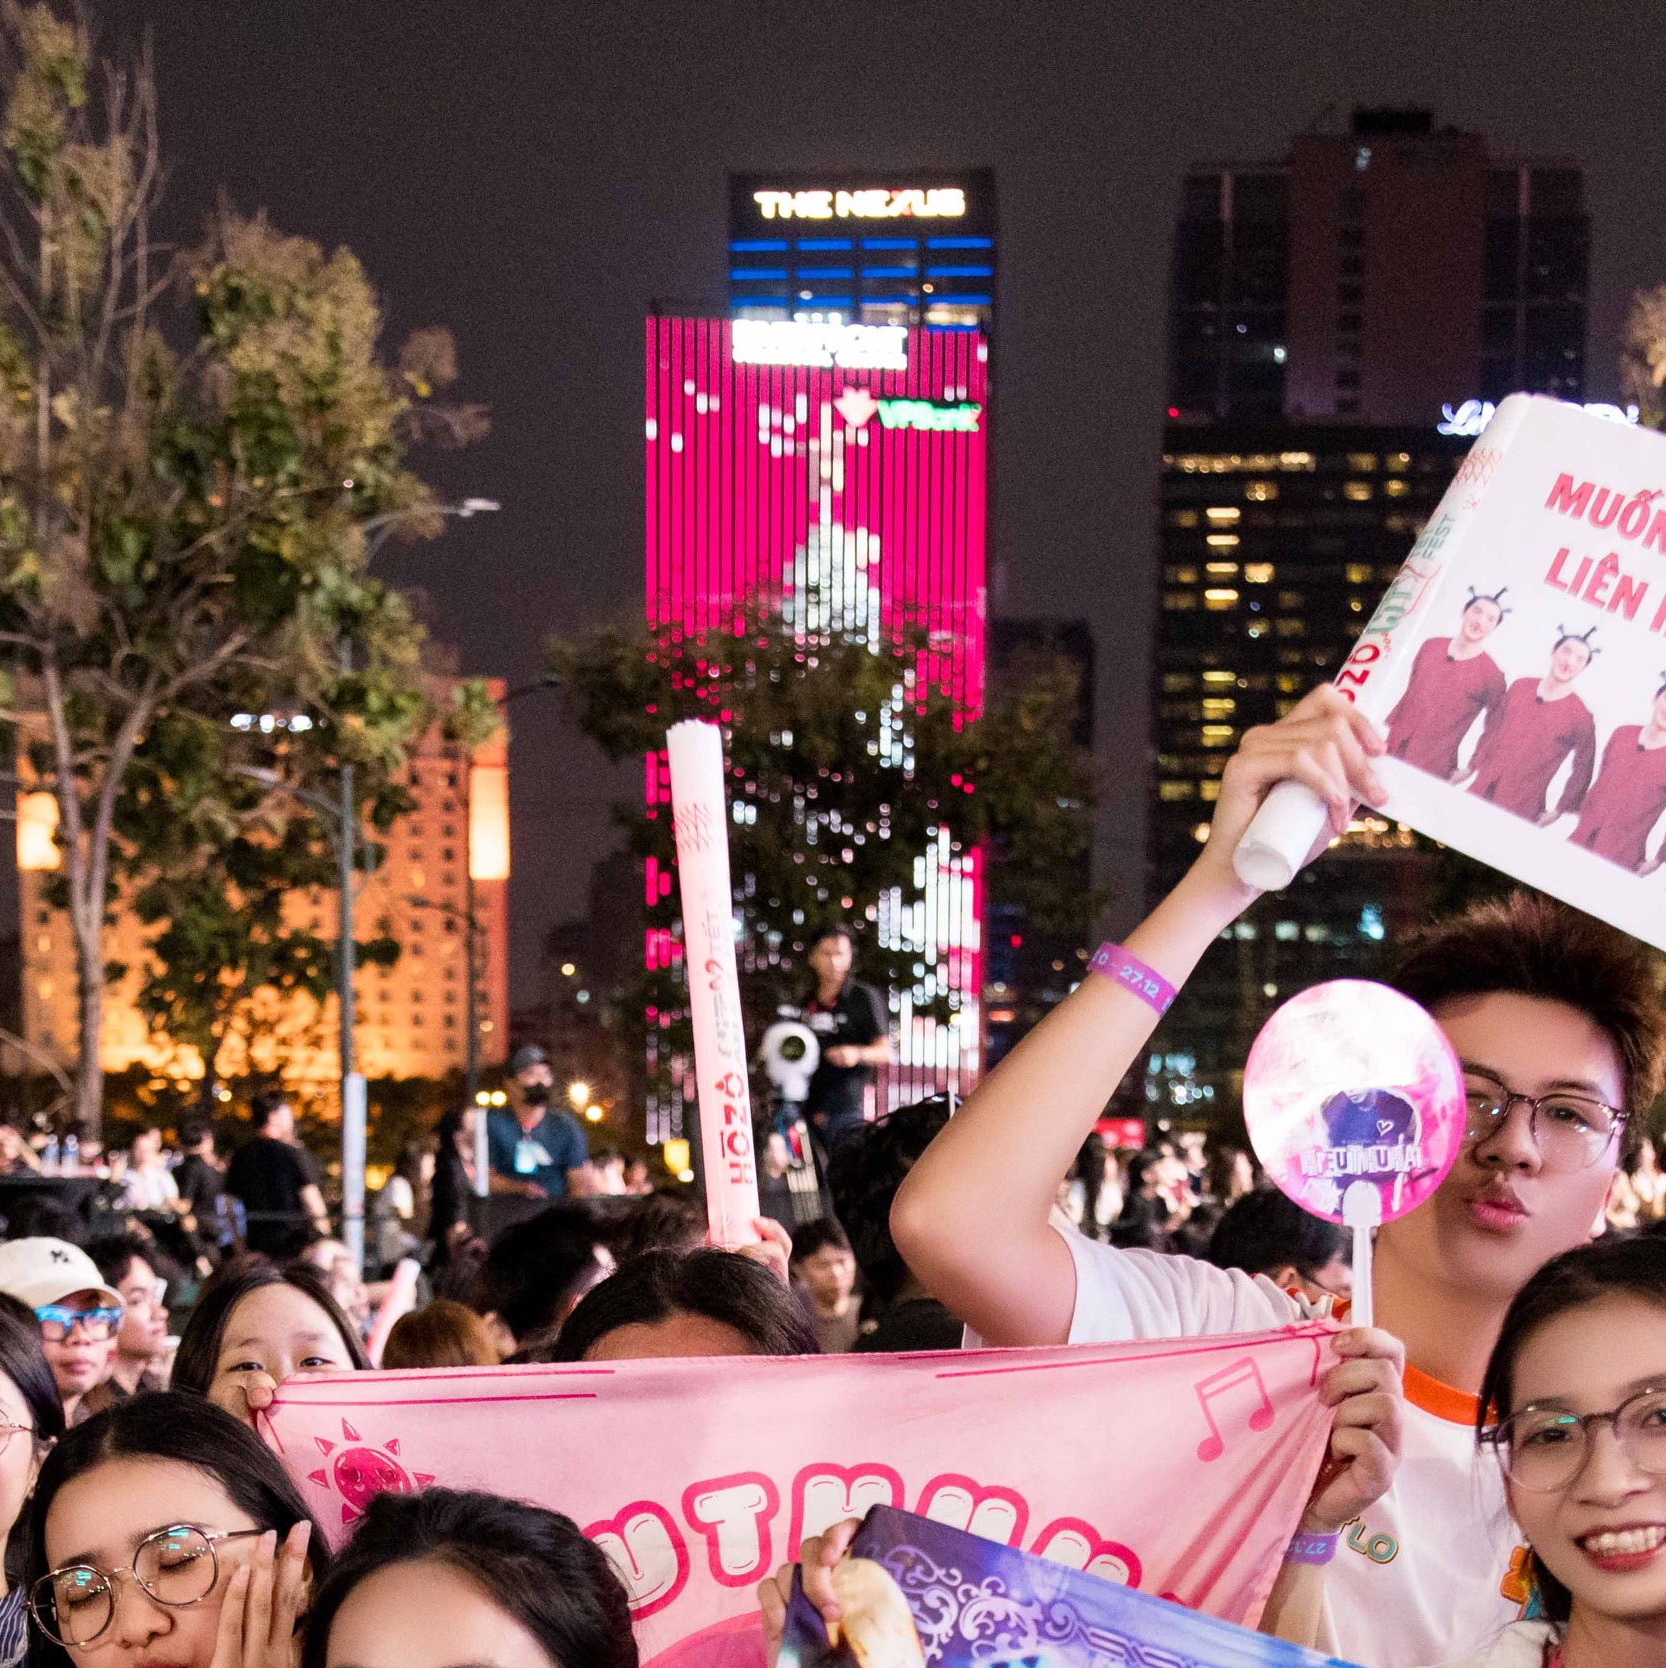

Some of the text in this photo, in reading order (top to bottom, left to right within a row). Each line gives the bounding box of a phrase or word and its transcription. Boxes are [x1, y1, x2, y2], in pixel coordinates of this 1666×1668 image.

[753, 188, 966, 220] THE NEXUS
[1543, 546, 1649, 622] LIÊN
